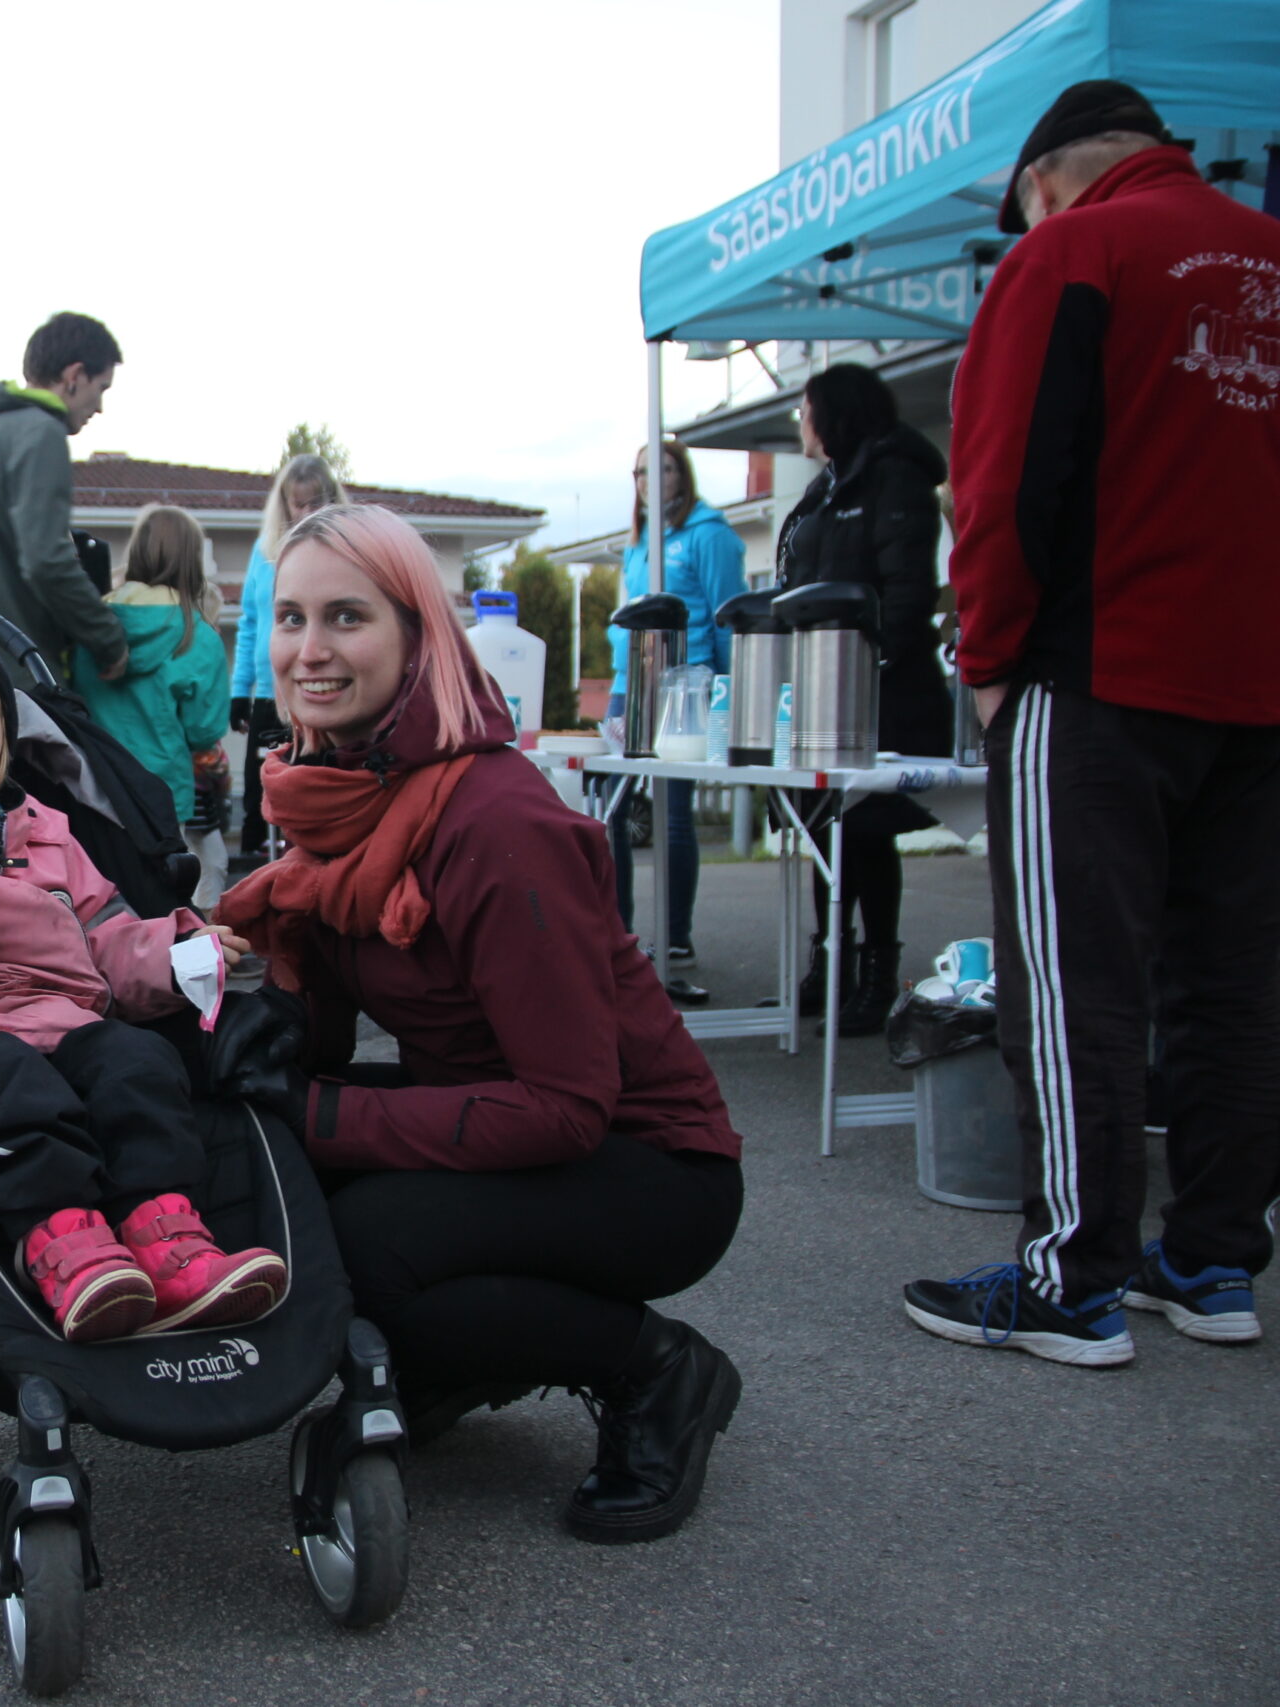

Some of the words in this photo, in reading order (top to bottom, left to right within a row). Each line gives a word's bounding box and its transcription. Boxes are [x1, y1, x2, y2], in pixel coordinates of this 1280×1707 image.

[707, 70, 983, 273] Säästöpankki
[1216, 382, 1278, 411] VIRRAT
[146, 1358, 182, 1383] city
[187, 1349, 235, 1374] mini
